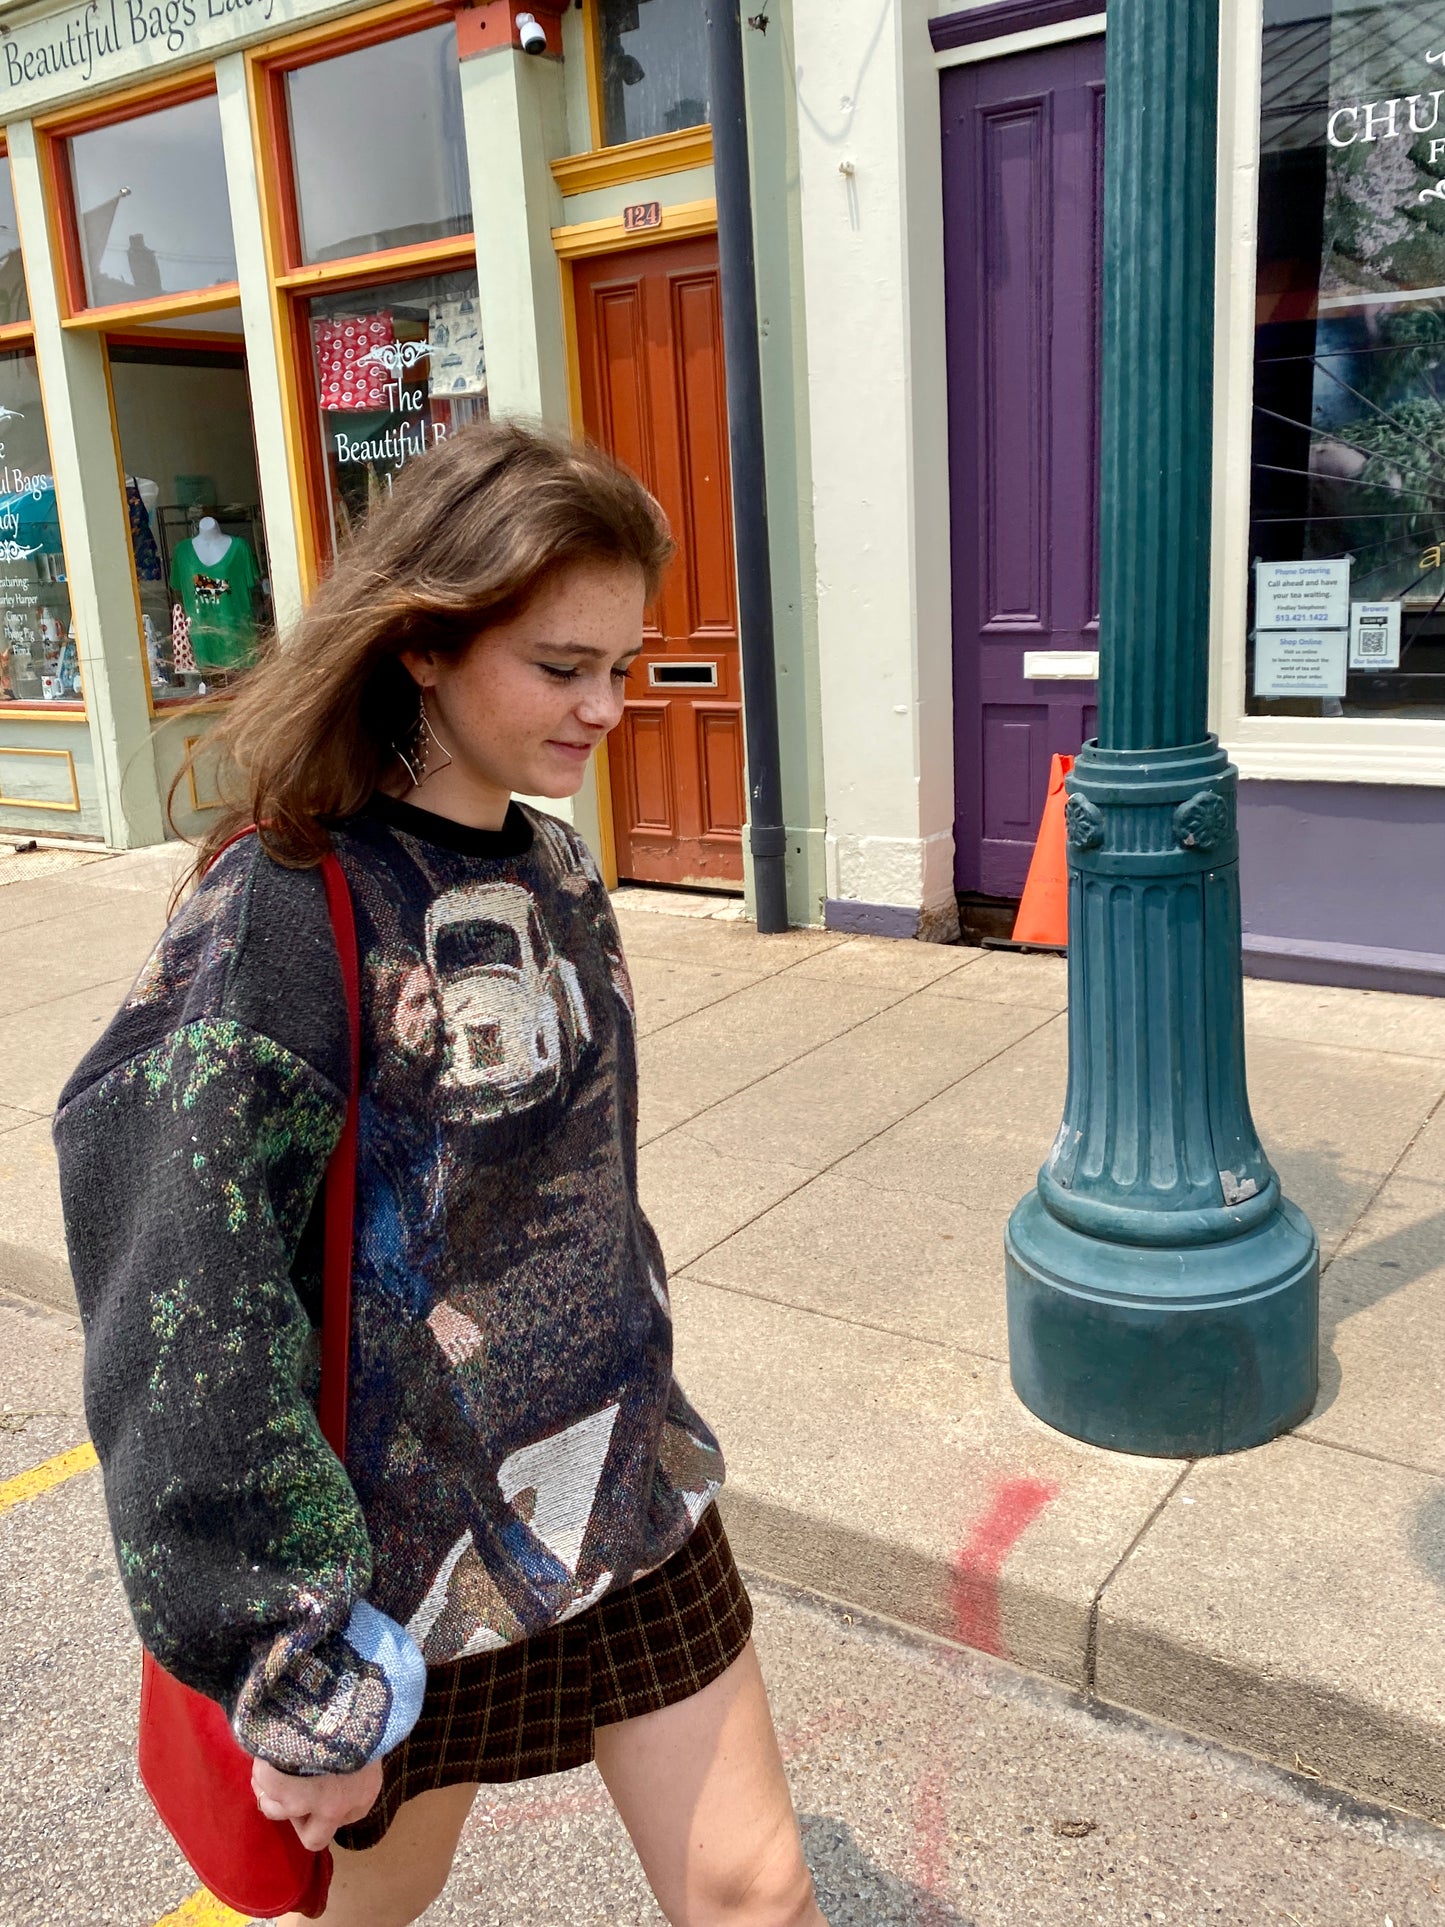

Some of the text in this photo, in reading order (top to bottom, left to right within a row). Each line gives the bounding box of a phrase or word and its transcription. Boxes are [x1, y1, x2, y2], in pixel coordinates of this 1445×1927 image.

[3, 0, 122, 87] Beautiful
[125, 0, 196, 51] Bags
[627, 203, 657, 228] 124
[382, 377, 423, 414] The
[335, 419, 427, 468] Beautiful
[12, 468, 48, 501] Bags
[1299, 567, 1331, 575] Ordering
[15, 593, 38, 608] Harper
[1273, 592, 1289, 600] your
[1303, 591, 1332, 599] waiting.
[1362, 605, 1389, 613] Browse
[1275, 613, 1329, 621] 513.421.1422
[1279, 638, 1297, 646] Shop
